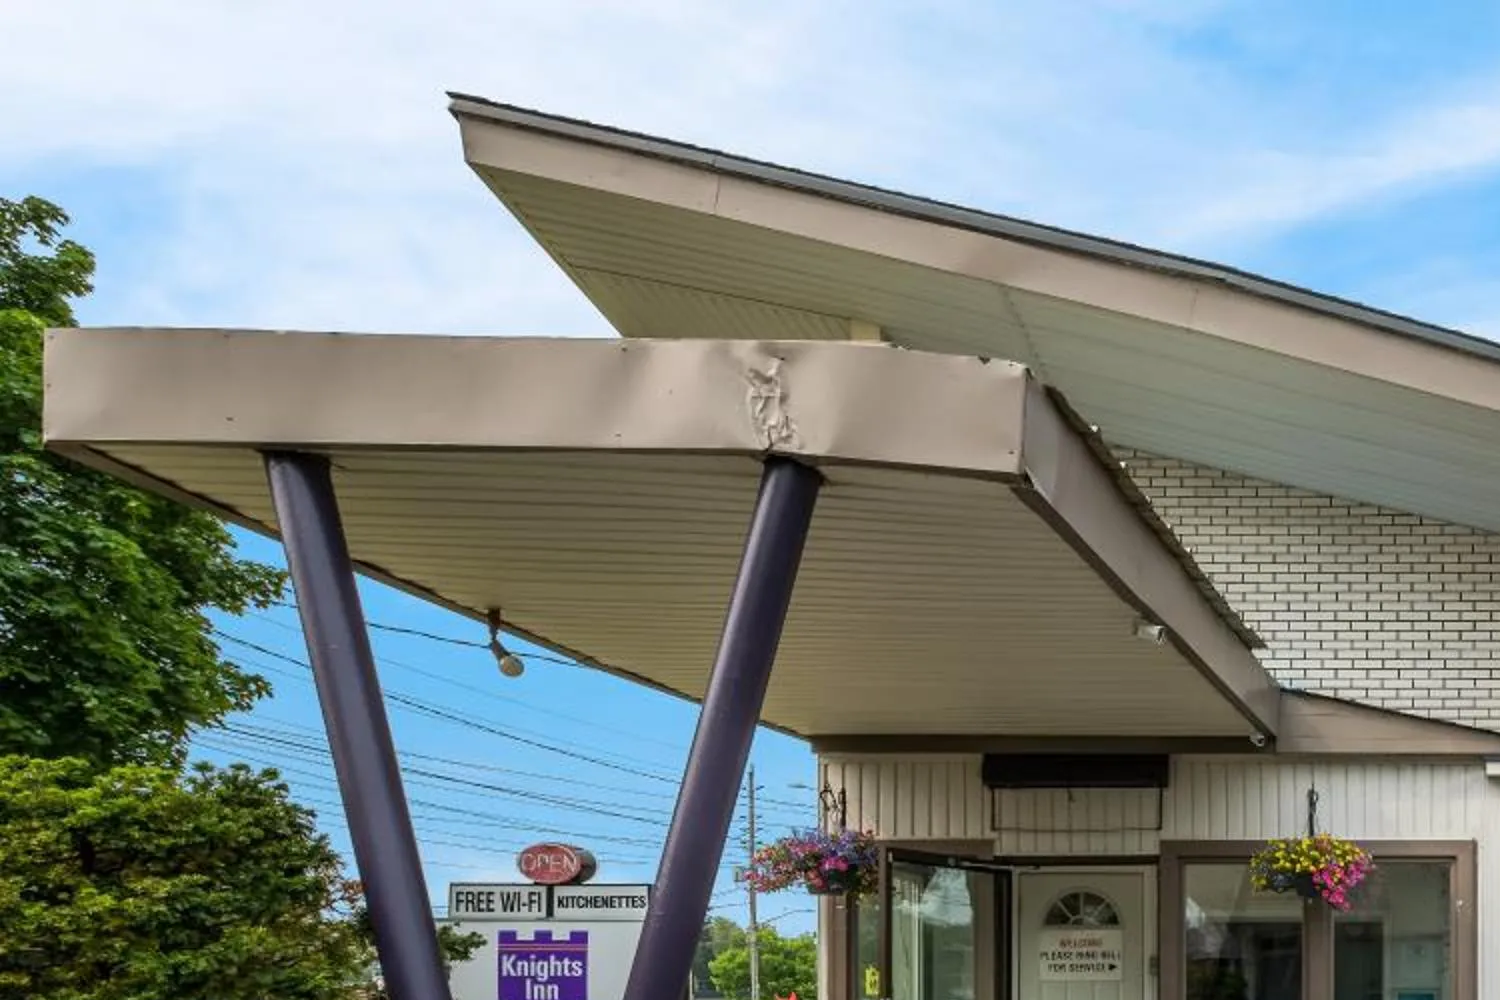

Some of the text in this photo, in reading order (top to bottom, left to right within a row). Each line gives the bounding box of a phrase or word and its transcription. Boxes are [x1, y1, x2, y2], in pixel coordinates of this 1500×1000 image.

[521, 853, 578, 873] OPEN
[455, 891, 542, 912] FREE WI-FI
[557, 895, 646, 909] KITCHENETTES
[502, 954, 583, 982] Knights
[525, 978, 559, 1000] Inn
